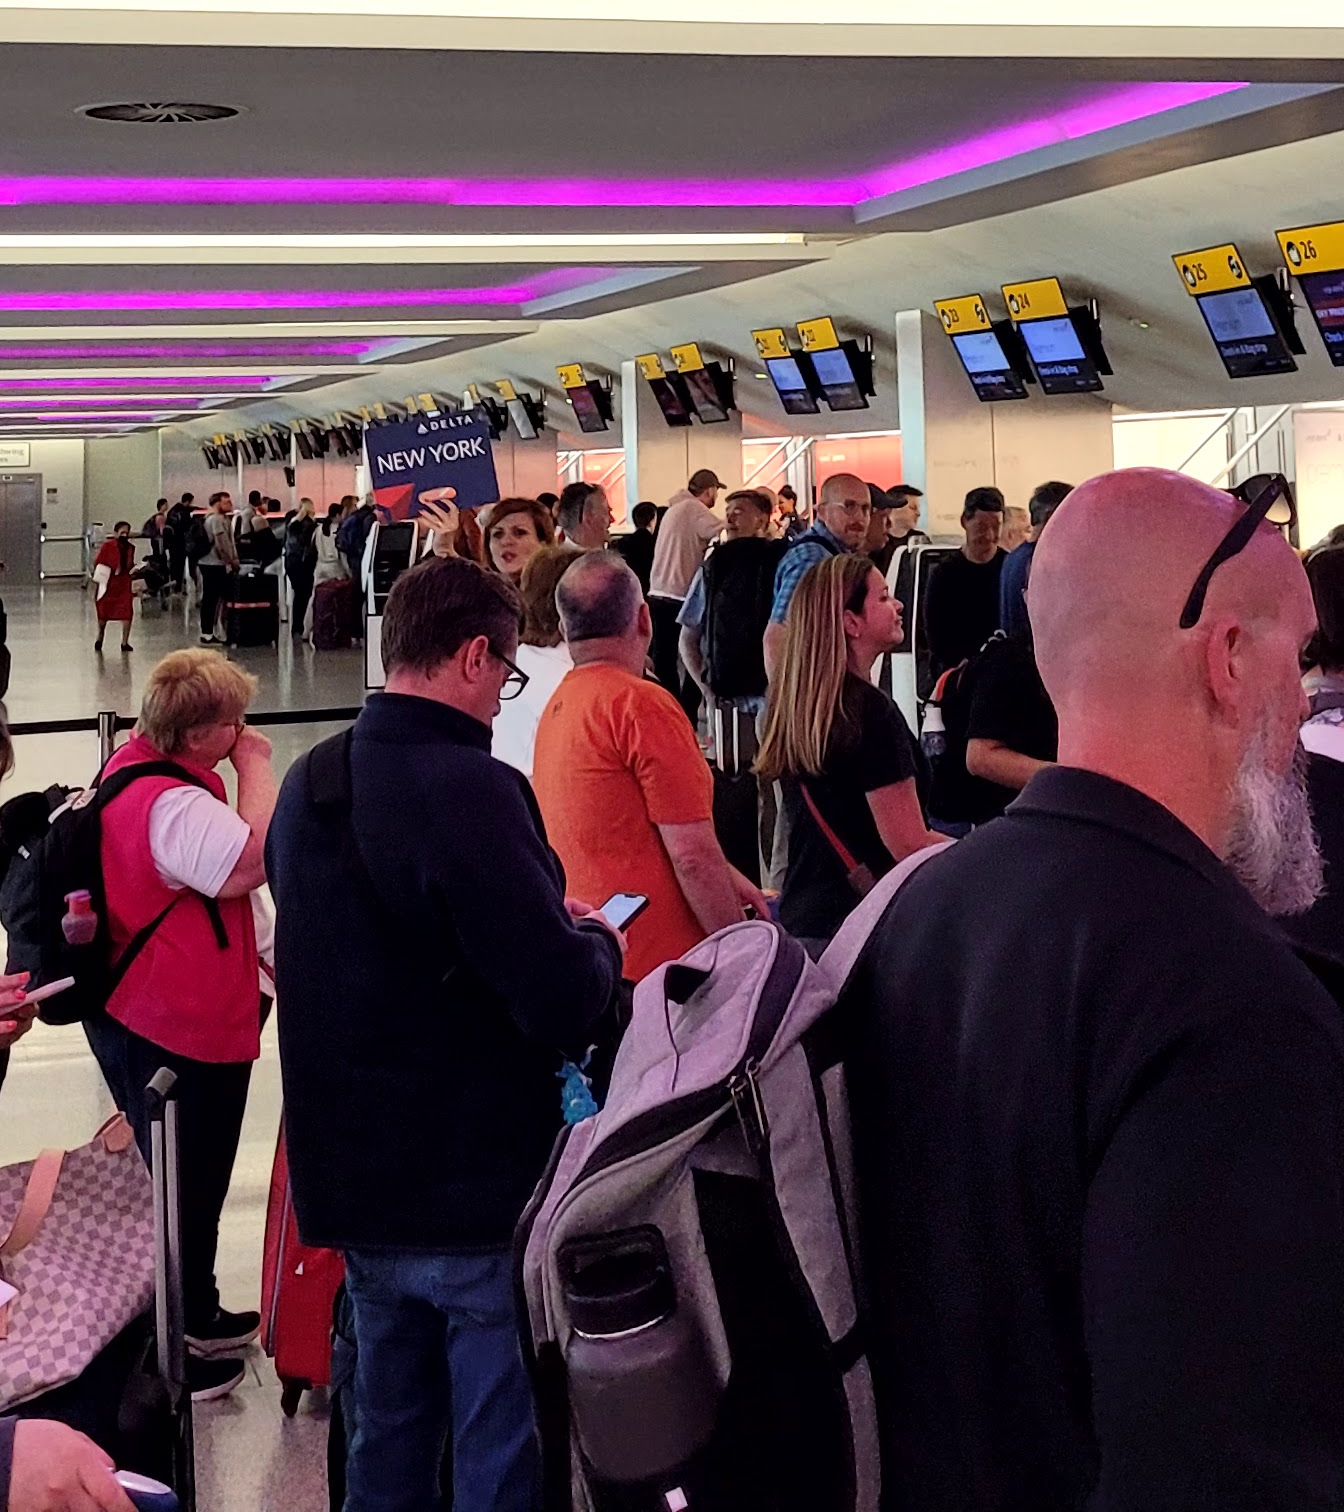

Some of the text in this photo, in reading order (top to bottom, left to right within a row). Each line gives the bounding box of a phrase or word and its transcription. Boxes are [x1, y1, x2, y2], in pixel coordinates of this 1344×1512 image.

[1299, 240, 1317, 259] 26
[429, 414, 474, 431] DELTA
[376, 437, 486, 474] NEW YORK
